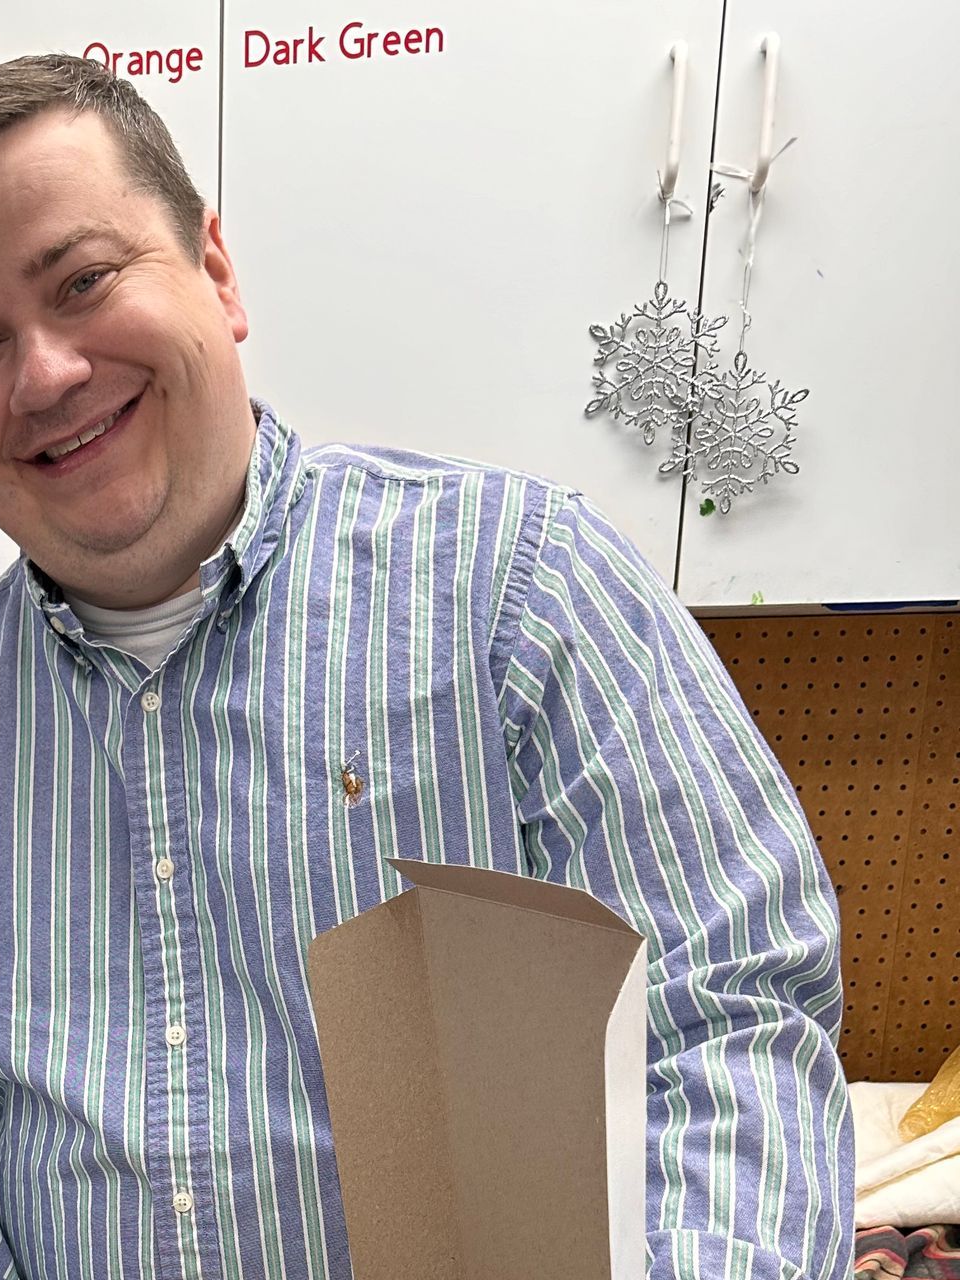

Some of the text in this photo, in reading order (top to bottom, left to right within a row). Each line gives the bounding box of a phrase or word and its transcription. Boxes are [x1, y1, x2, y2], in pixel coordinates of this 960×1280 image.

[83, 41, 203, 83] Orange
[244, 22, 444, 68] Dark Green
